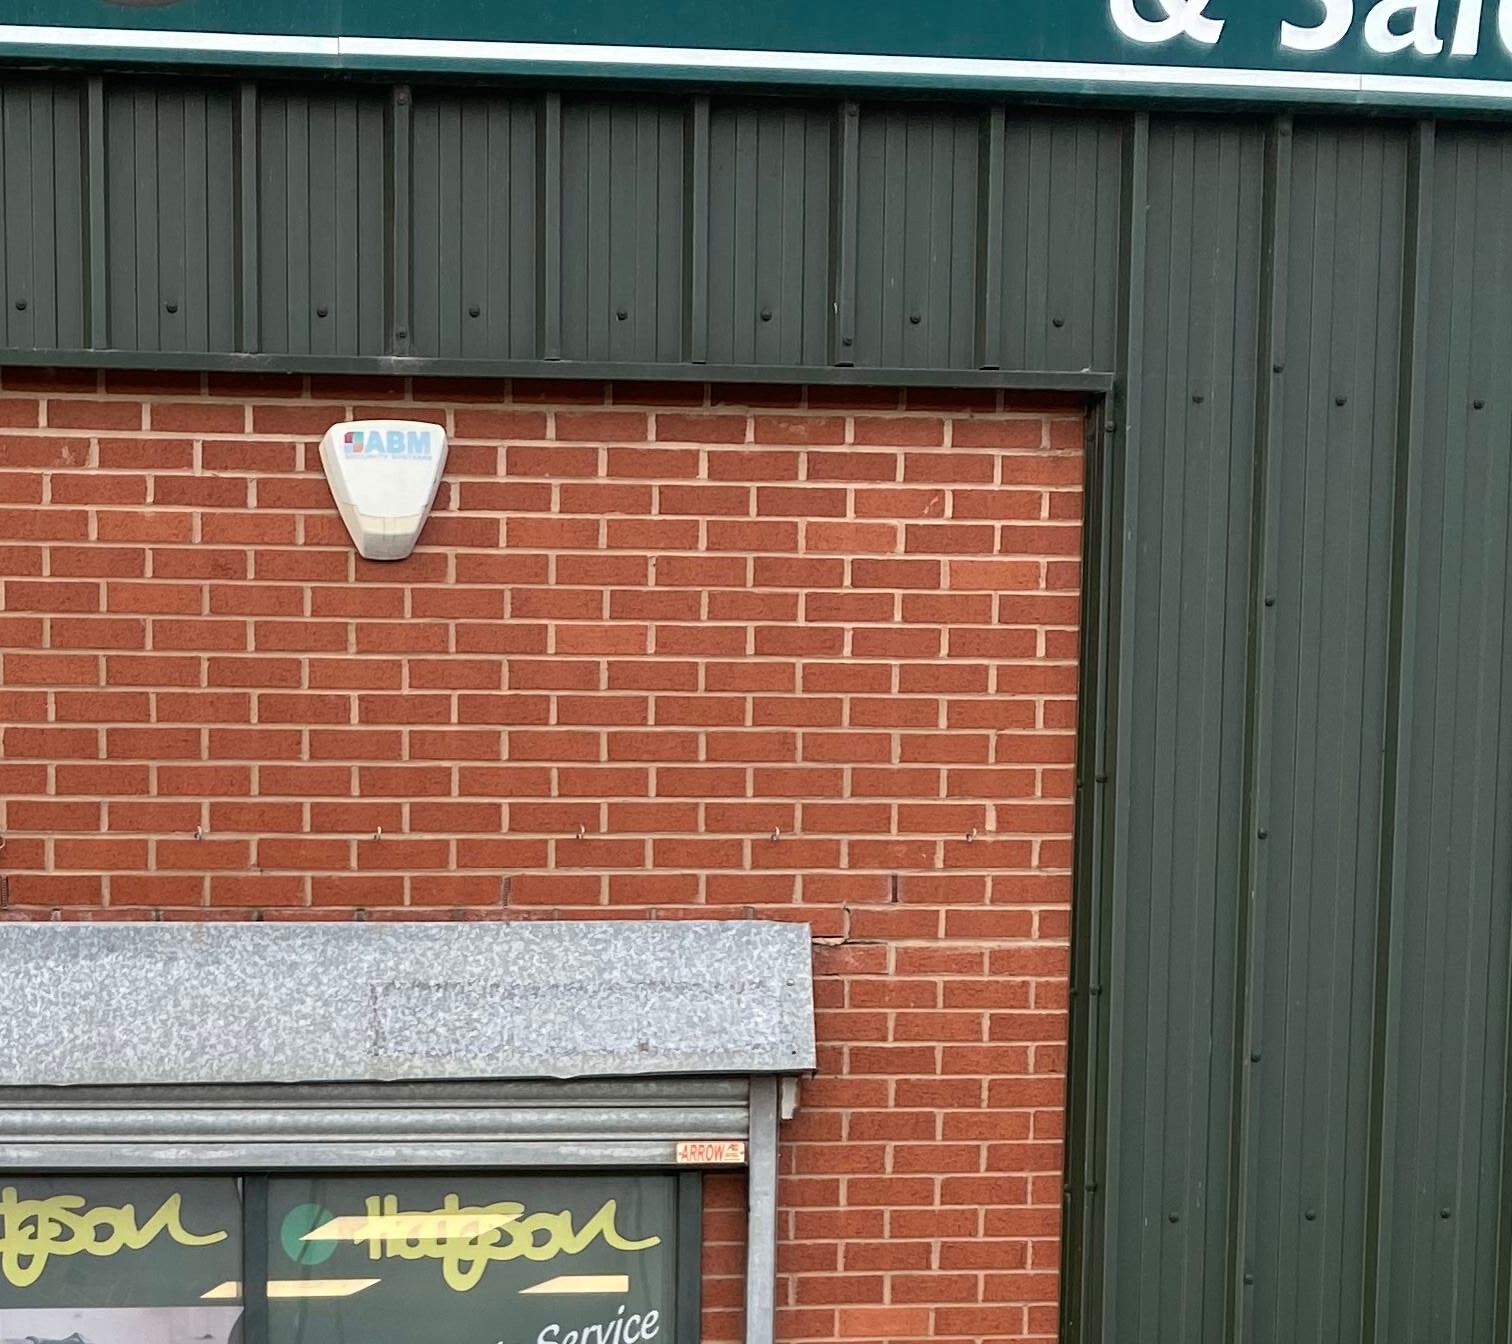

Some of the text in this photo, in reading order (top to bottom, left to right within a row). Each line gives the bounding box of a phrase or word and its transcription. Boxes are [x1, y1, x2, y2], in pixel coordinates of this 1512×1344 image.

[366, 431, 431, 454] ABM
[682, 1143, 725, 1162] ARROW
[353, 1193, 662, 1293] Hodgson
